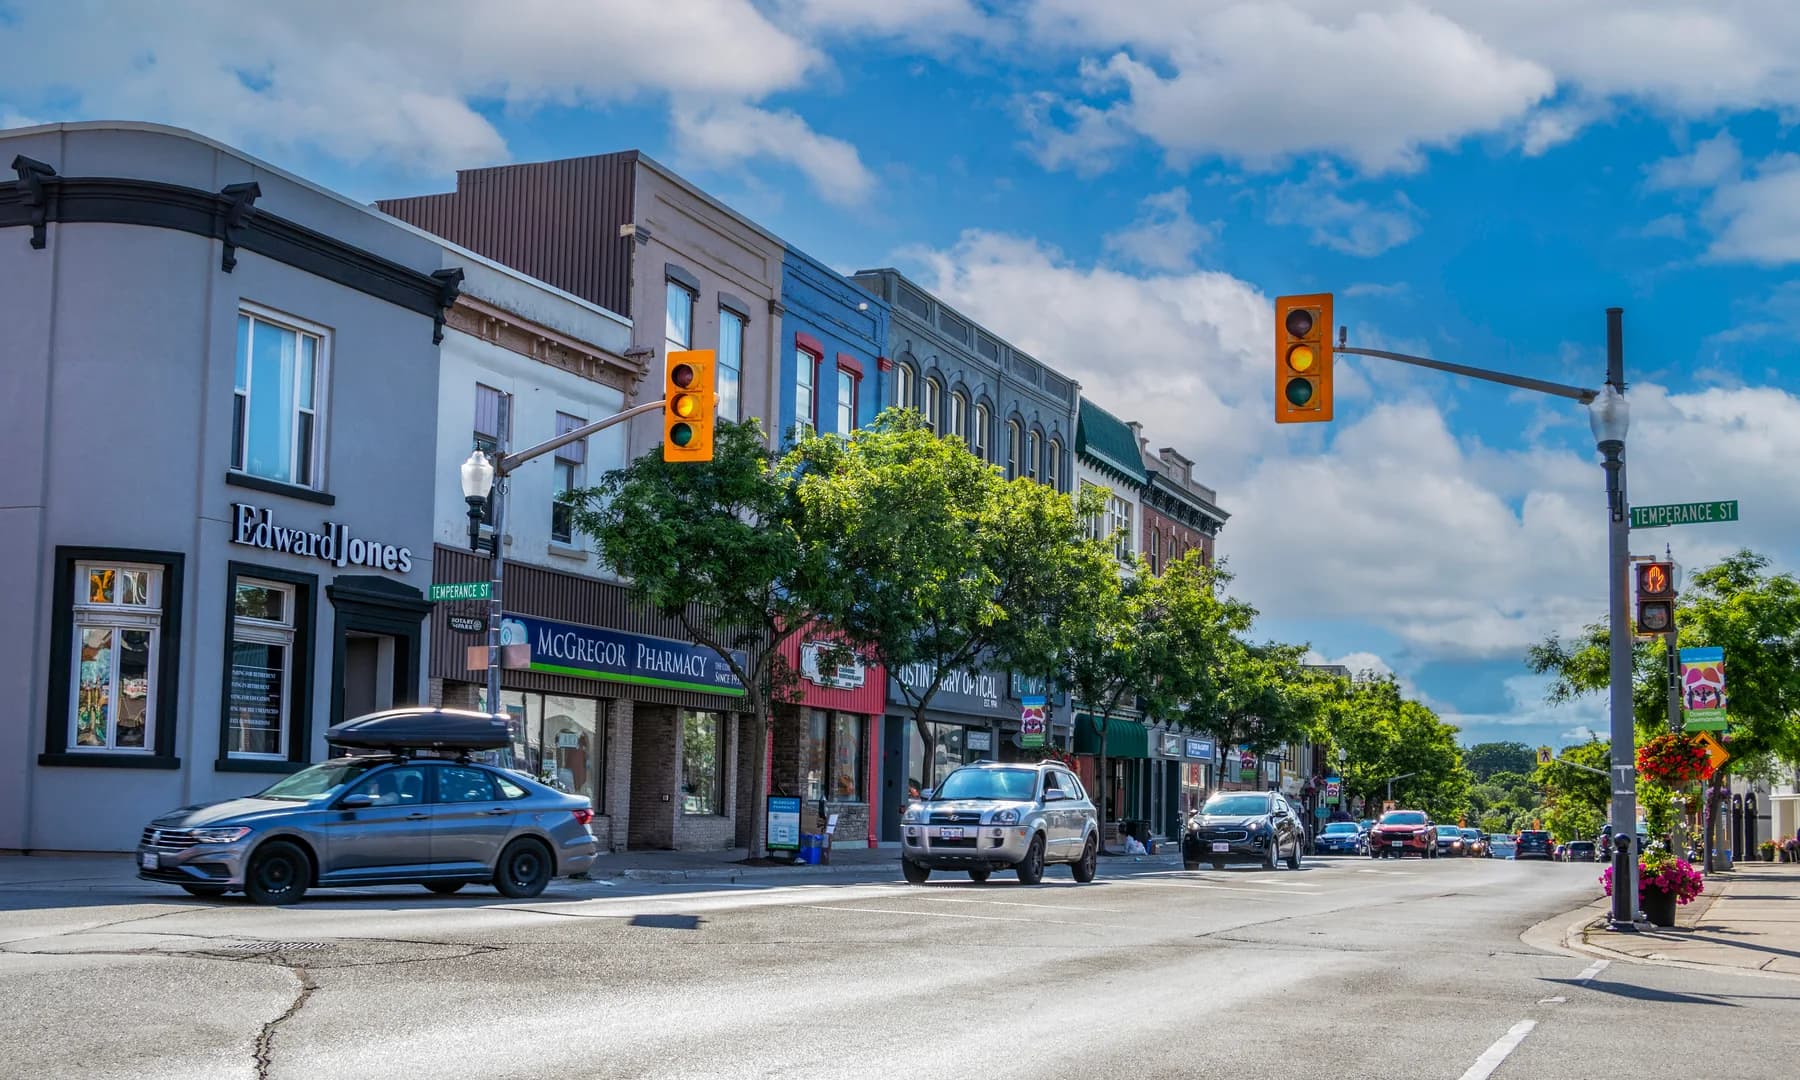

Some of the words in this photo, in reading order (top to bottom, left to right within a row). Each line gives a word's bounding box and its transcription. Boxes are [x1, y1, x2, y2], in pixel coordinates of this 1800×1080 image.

[1634, 503, 1713, 525] TEMPERANCE
[1719, 502, 1733, 520] ST
[232, 503, 336, 561] Edward
[336, 524, 413, 573] Jones
[432, 584, 477, 599] TEMPERANCE
[480, 583, 489, 597] ST
[636, 643, 708, 678] PHARMACY
[714, 671, 730, 684] SINCE
[962, 671, 997, 699] OPTICAL
